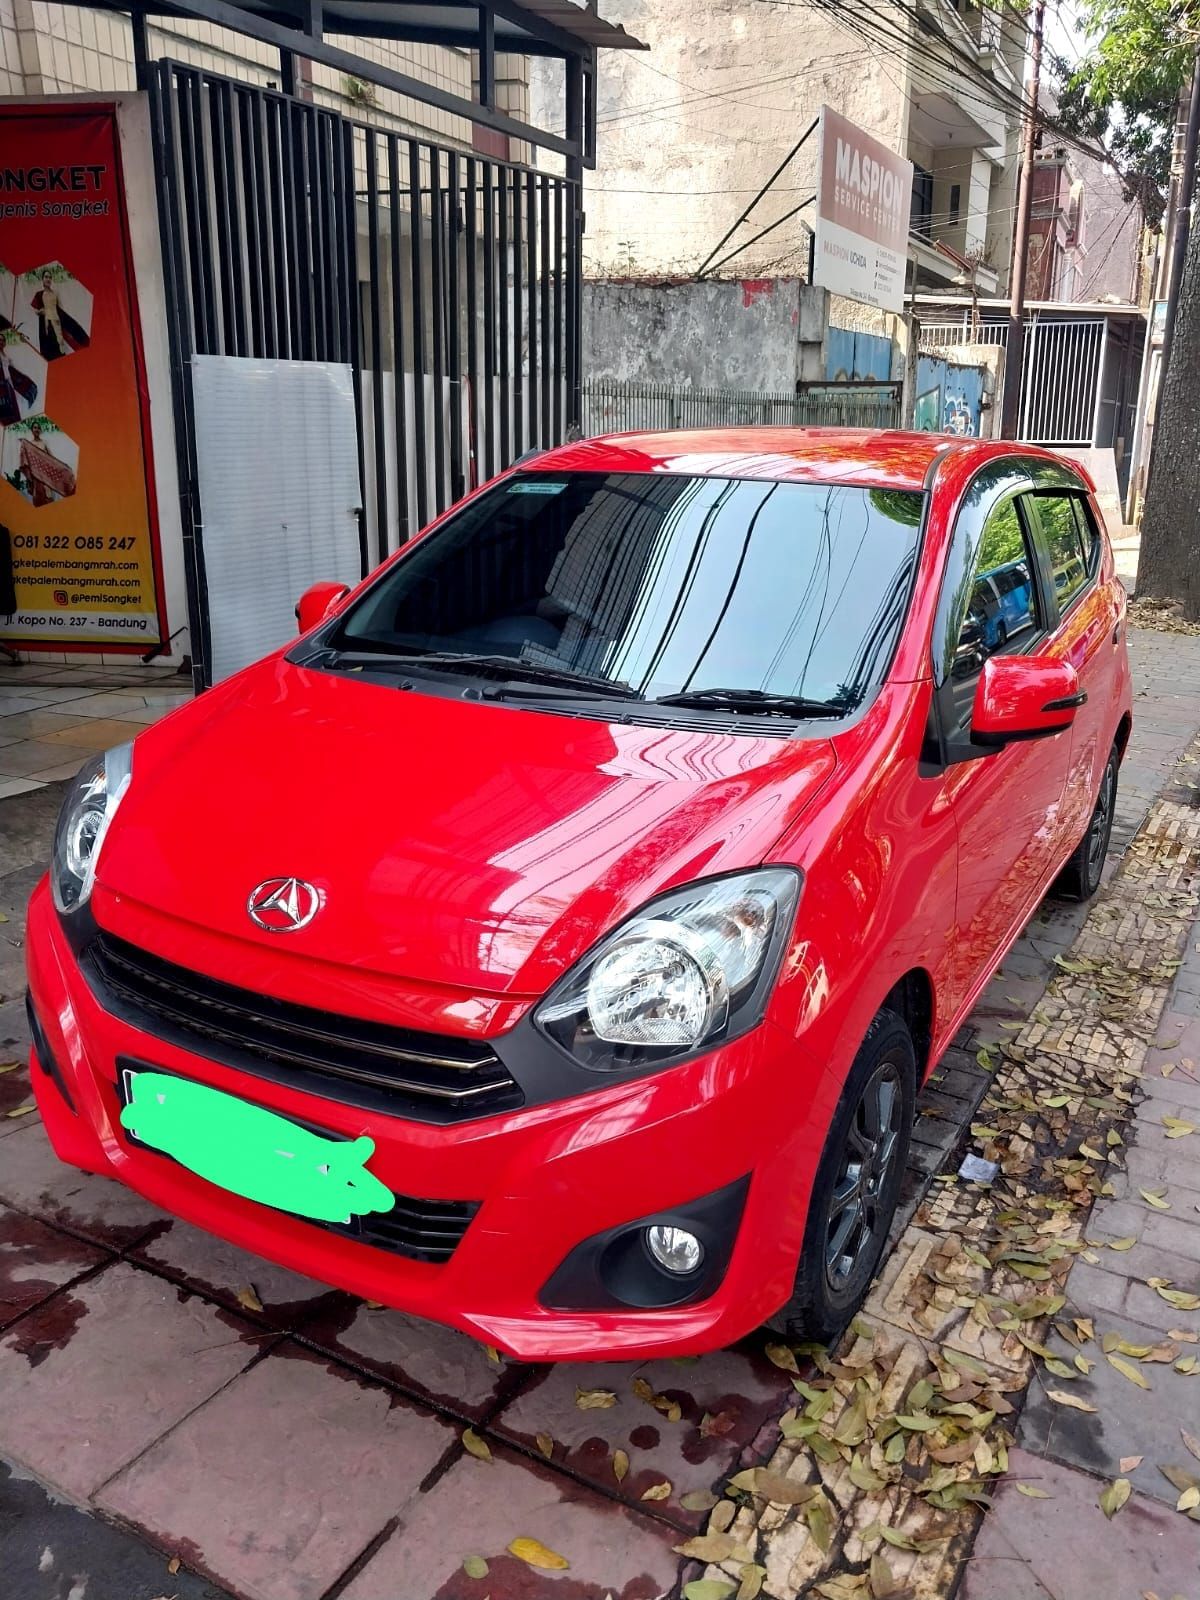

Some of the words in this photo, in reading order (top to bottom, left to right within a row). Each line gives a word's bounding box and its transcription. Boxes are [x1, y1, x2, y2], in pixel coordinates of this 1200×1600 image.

[835, 138, 904, 215] MASPION
[42, 198, 109, 220] Songket
[834, 186, 870, 217] SERVICE
[823, 239, 849, 264] MASPION
[13, 535, 39, 548] 081
[43, 536, 69, 549] 322
[75, 536, 104, 549] 085
[109, 537, 136, 550] 247
[11, 559, 139, 570] gketpalembangmrah.com
[18, 616, 46, 627] Kopo
[49, 617, 66, 626] No.
[69, 617, 87, 626] 237
[98, 618, 147, 630] Bandung
